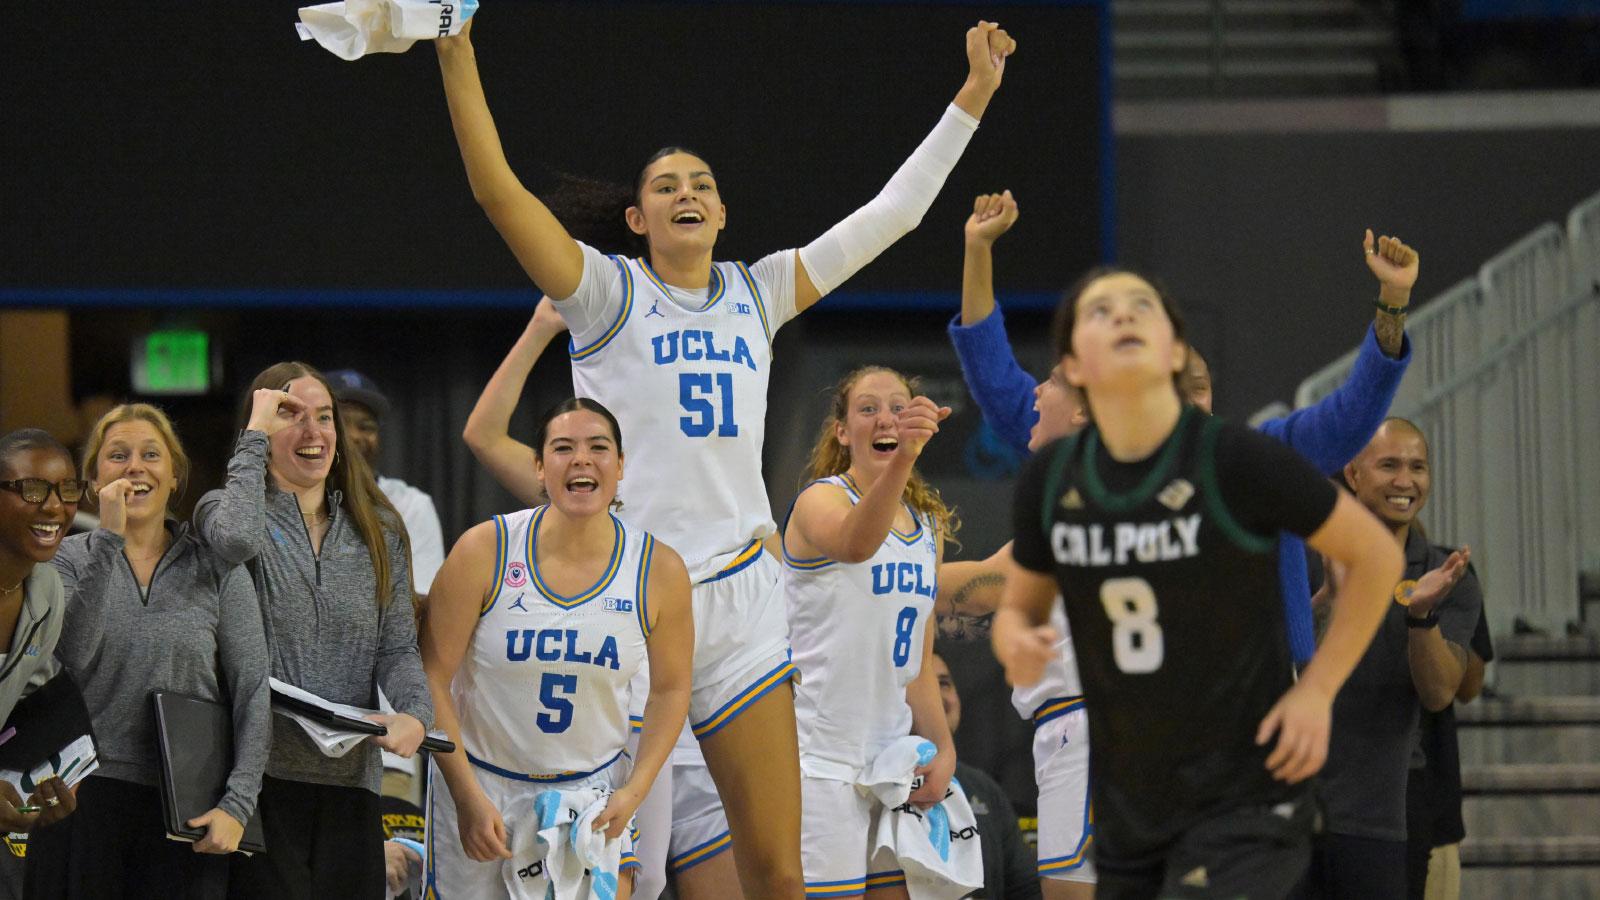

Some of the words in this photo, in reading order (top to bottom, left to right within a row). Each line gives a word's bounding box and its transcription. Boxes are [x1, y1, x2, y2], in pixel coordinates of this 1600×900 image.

[652, 330, 757, 371] UCLA
[679, 373, 738, 437] 51
[1051, 522, 1112, 567] CAL
[1113, 513, 1202, 565] POLY
[506, 629, 620, 670] UCLA
[892, 606, 918, 668] 8
[1100, 576, 1164, 673] 8
[536, 673, 578, 733] 5
